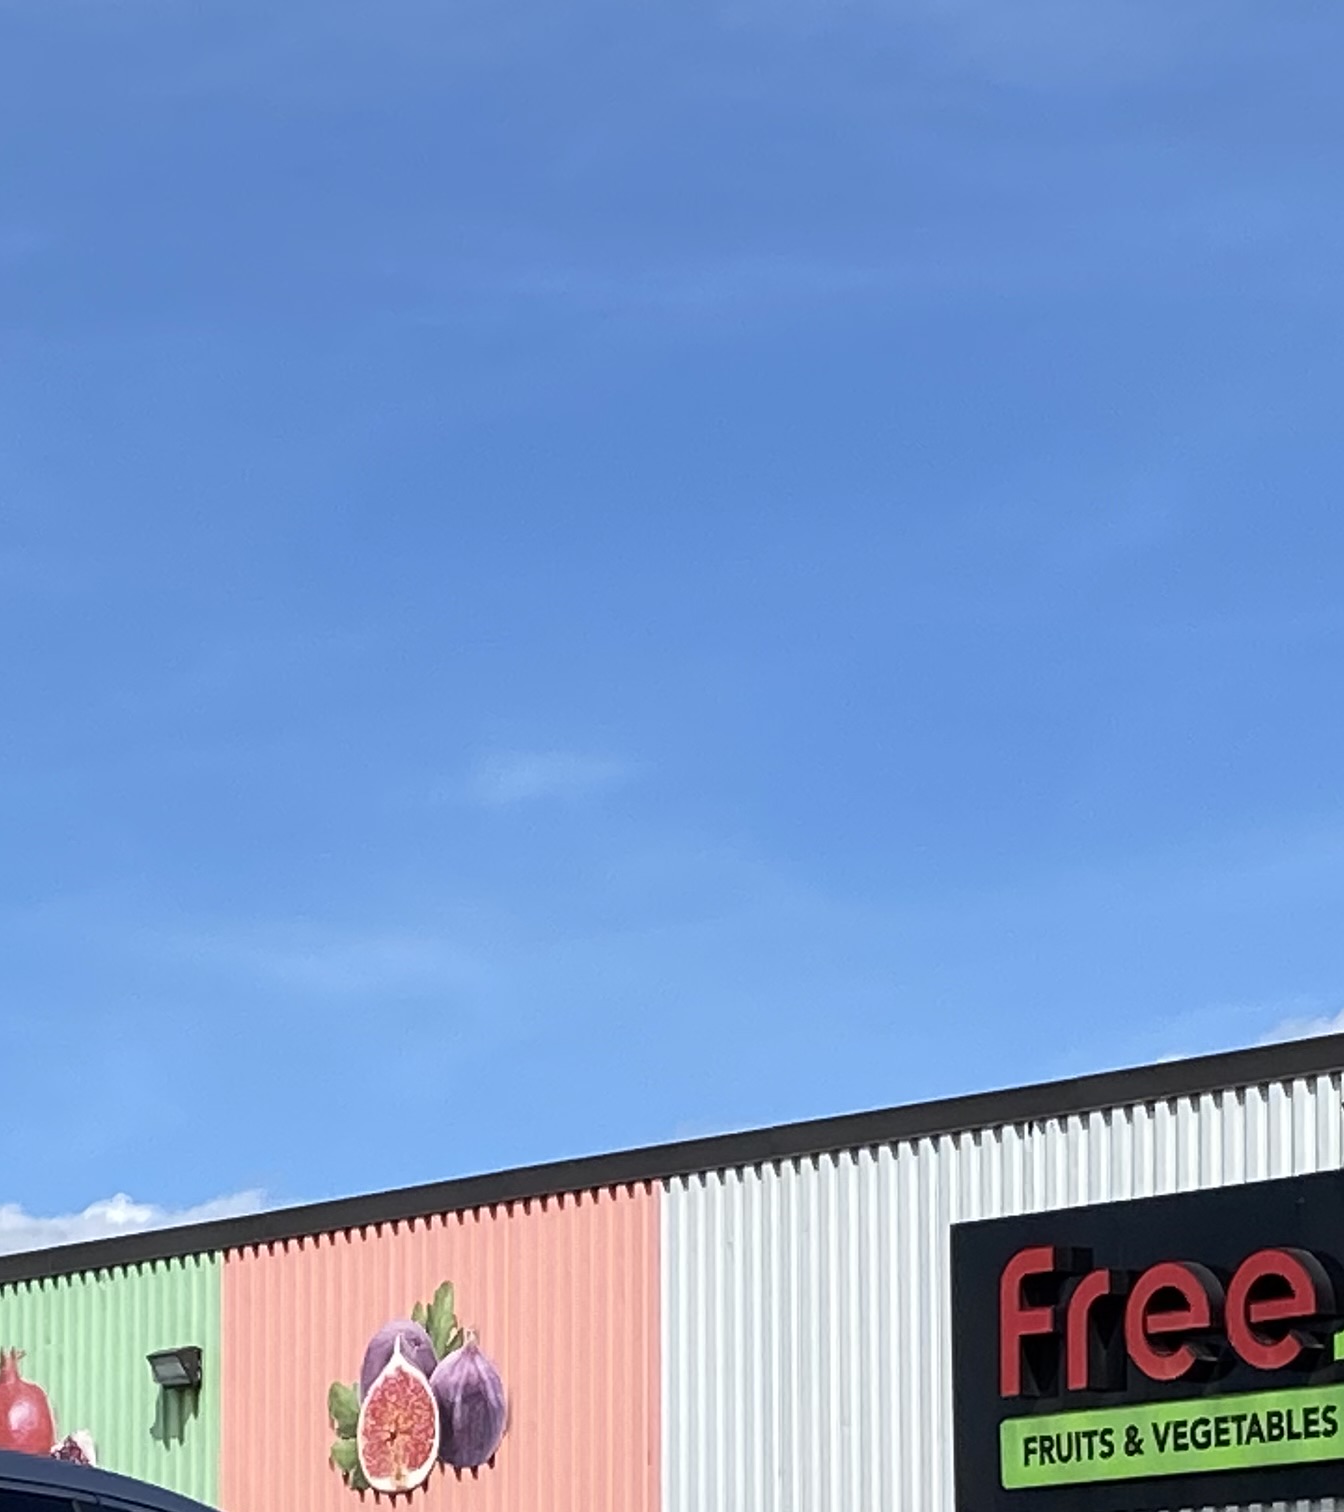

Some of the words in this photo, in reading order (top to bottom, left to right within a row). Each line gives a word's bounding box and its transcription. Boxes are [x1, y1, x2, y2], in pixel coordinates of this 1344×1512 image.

[1022, 1427, 1116, 1467] FRUITS
[1123, 1424, 1145, 1457] &
[1151, 1404, 1340, 1453] VEGETABLES
